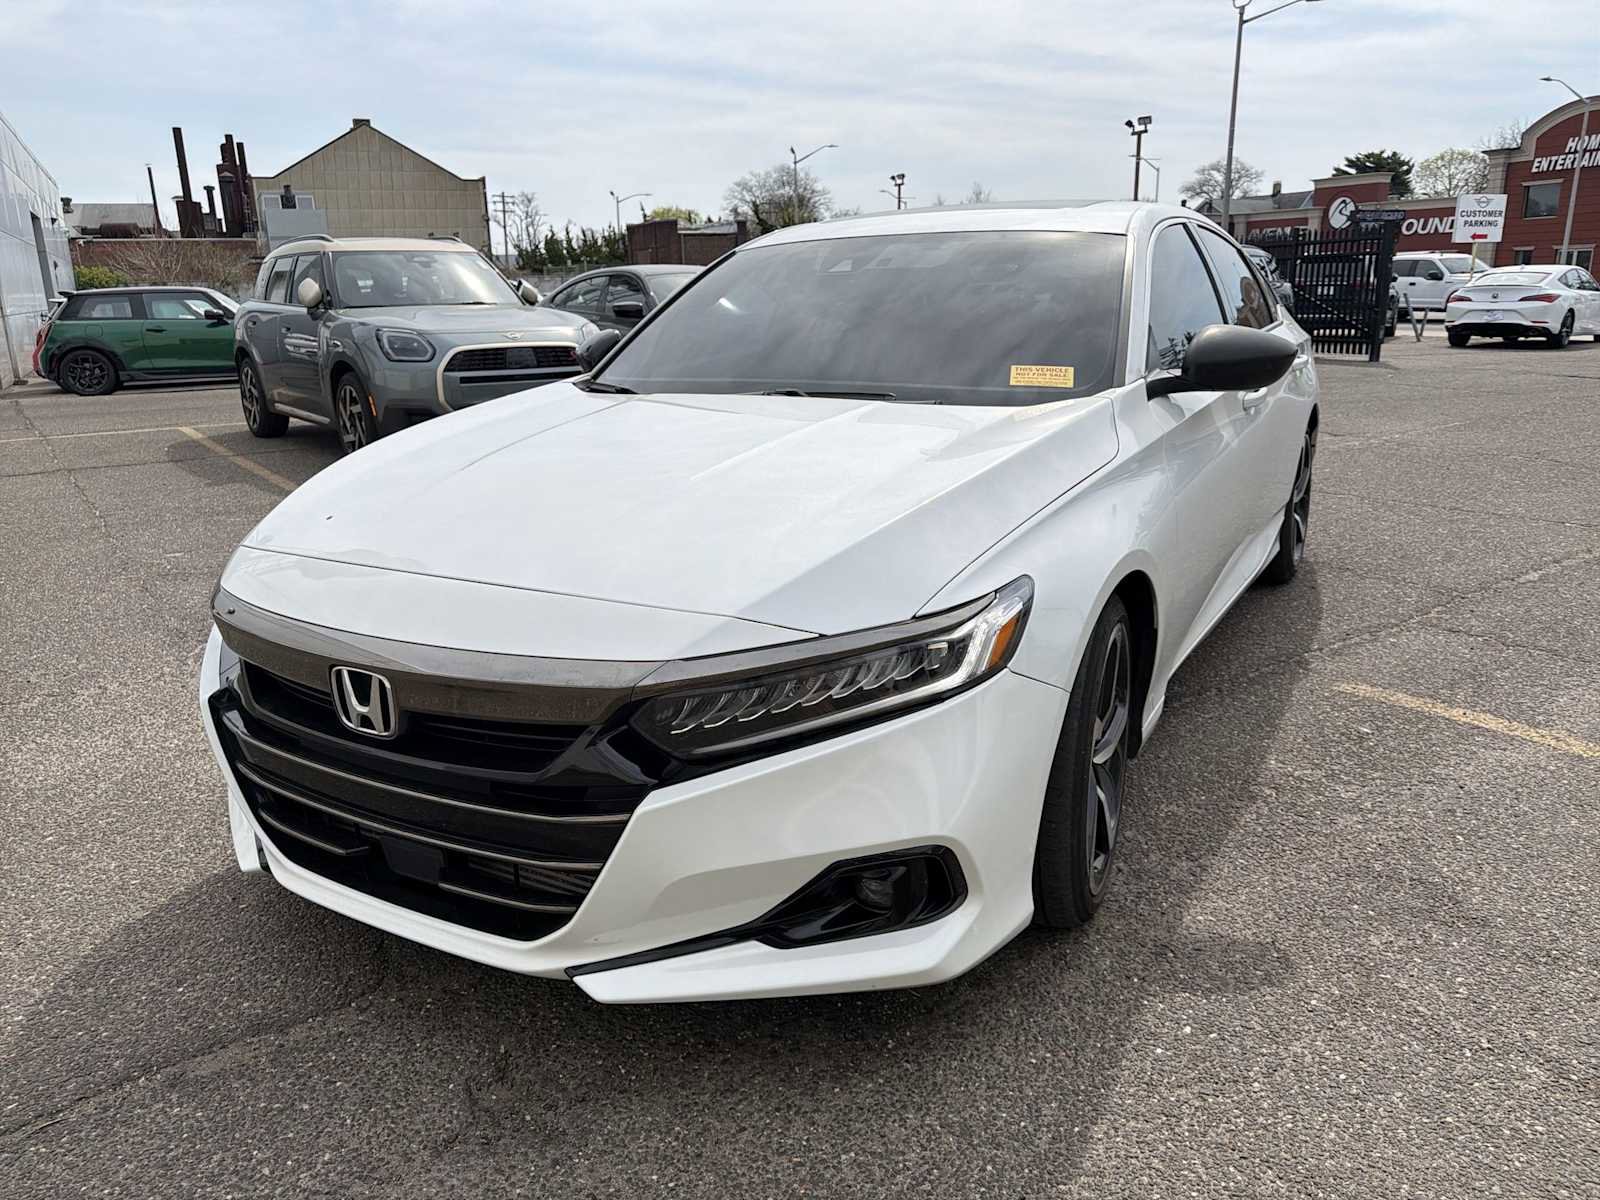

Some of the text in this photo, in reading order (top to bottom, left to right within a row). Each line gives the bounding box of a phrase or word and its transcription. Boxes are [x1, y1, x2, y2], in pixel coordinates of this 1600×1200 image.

[1565, 134, 1600, 153] HOM
[1460, 210, 1504, 218] CUSTOMER
[1464, 219, 1499, 228] PARKING
